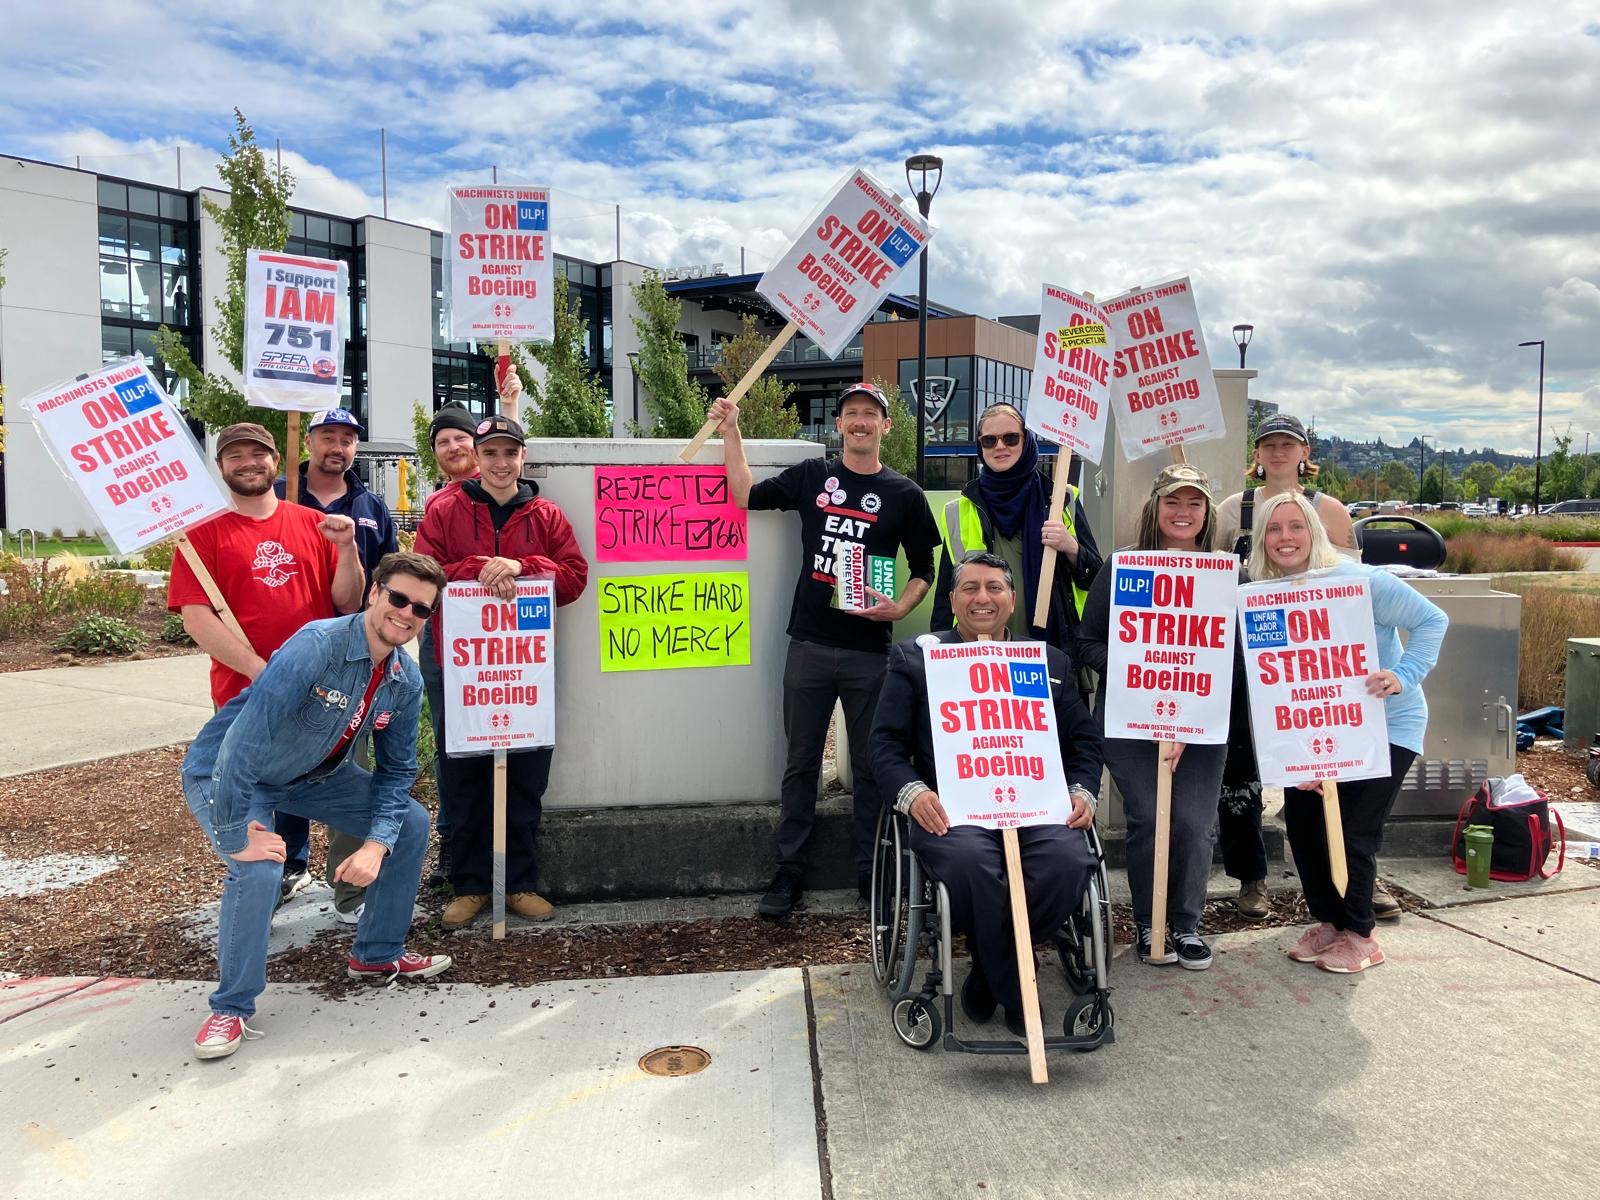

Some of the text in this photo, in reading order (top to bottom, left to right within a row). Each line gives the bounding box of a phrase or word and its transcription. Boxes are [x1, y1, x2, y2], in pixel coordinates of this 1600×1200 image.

[456, 190, 545, 200] MACHINISTS UNION
[485, 204, 517, 230] ON
[521, 208, 545, 220] ULP!
[854, 176, 926, 243] MACHINISTS UNION
[857, 209, 894, 248] ON
[459, 233, 544, 261] STRIKE
[817, 215, 893, 289] STRIKE
[890, 234, 913, 257] ULP!
[267, 268, 335, 289] I Support
[482, 265, 523, 275] AGAINST
[821, 252, 857, 285] AGAINST
[469, 276, 536, 299] Boeing
[797, 253, 858, 313] Boeing
[265, 284, 335, 325] IAM
[1047, 288, 1097, 316] MACHINISTS
[1103, 283, 1187, 314] ACHINISTS UNION
[1059, 328, 1084, 336] NEVER
[1069, 313, 1095, 327] O
[1127, 306, 1164, 340] ON
[265, 323, 332, 352] 751
[1068, 338, 1094, 346] PICKET
[261, 351, 309, 367] SPEEA
[1113, 329, 1200, 378] STRIKE
[37, 366, 142, 413] MACHINISTS UNION
[1058, 370, 1092, 392] AGAINST
[1138, 367, 1179, 388] AGAINST
[122, 382, 153, 403] ULP!
[1044, 376, 1098, 421] Boeing
[1127, 378, 1200, 413] Boeing
[82, 392, 129, 429] ON
[70, 410, 175, 473] STRIKE
[113, 451, 160, 479] AGAINST
[105, 458, 188, 507] Boeing
[597, 475, 693, 501] REJECT
[158, 513, 180, 528] DISTRICT
[599, 504, 686, 549] STRIKE
[825, 515, 870, 538] EAT
[821, 535, 865, 554] TH
[844, 549, 852, 604] FOREVER!
[1119, 555, 1233, 570] MACHINISTS UNION
[448, 586, 548, 597] MACHINI UNION
[852, 546, 863, 609] SOLIDARITY
[884, 561, 893, 598] UNIO
[1119, 578, 1149, 593] ULP!
[1153, 574, 1194, 608] ON
[603, 580, 742, 614] STRIKE HARD
[1246, 585, 1363, 607] MACHINISTS UNION
[481, 603, 517, 632] ON
[521, 605, 547, 617] ULP!
[1253, 613, 1277, 622] UNFAIR
[1119, 611, 1226, 648] STRIKE
[1248, 631, 1286, 642] PRACTICES!
[1255, 622, 1277, 632] LABOR
[1287, 608, 1330, 643] ON
[453, 636, 546, 667] STRIKE
[609, 621, 743, 659] NO MERCY
[930, 646, 1040, 660] MACHINISTS UNION
[1144, 650, 1195, 665] AGAINST
[1258, 643, 1368, 685] STRIKE
[478, 670, 523, 682] AGAINST
[969, 663, 1011, 693] ON
[1014, 671, 1043, 685] ULP!
[1127, 664, 1211, 696] Boeing
[463, 683, 537, 707] Boeing
[1291, 685, 1342, 701] AGAINST
[940, 699, 1048, 733] STRIKE
[1150, 723, 1175, 731] DISTRICT
[1177, 725, 1194, 733] LODGE
[1275, 702, 1363, 730] Boeing
[972, 735, 1023, 749] AGAINST
[957, 752, 1044, 781] Boeing
[1310, 762, 1336, 771] DISTRICT
[1355, 759, 1363, 767] 751
